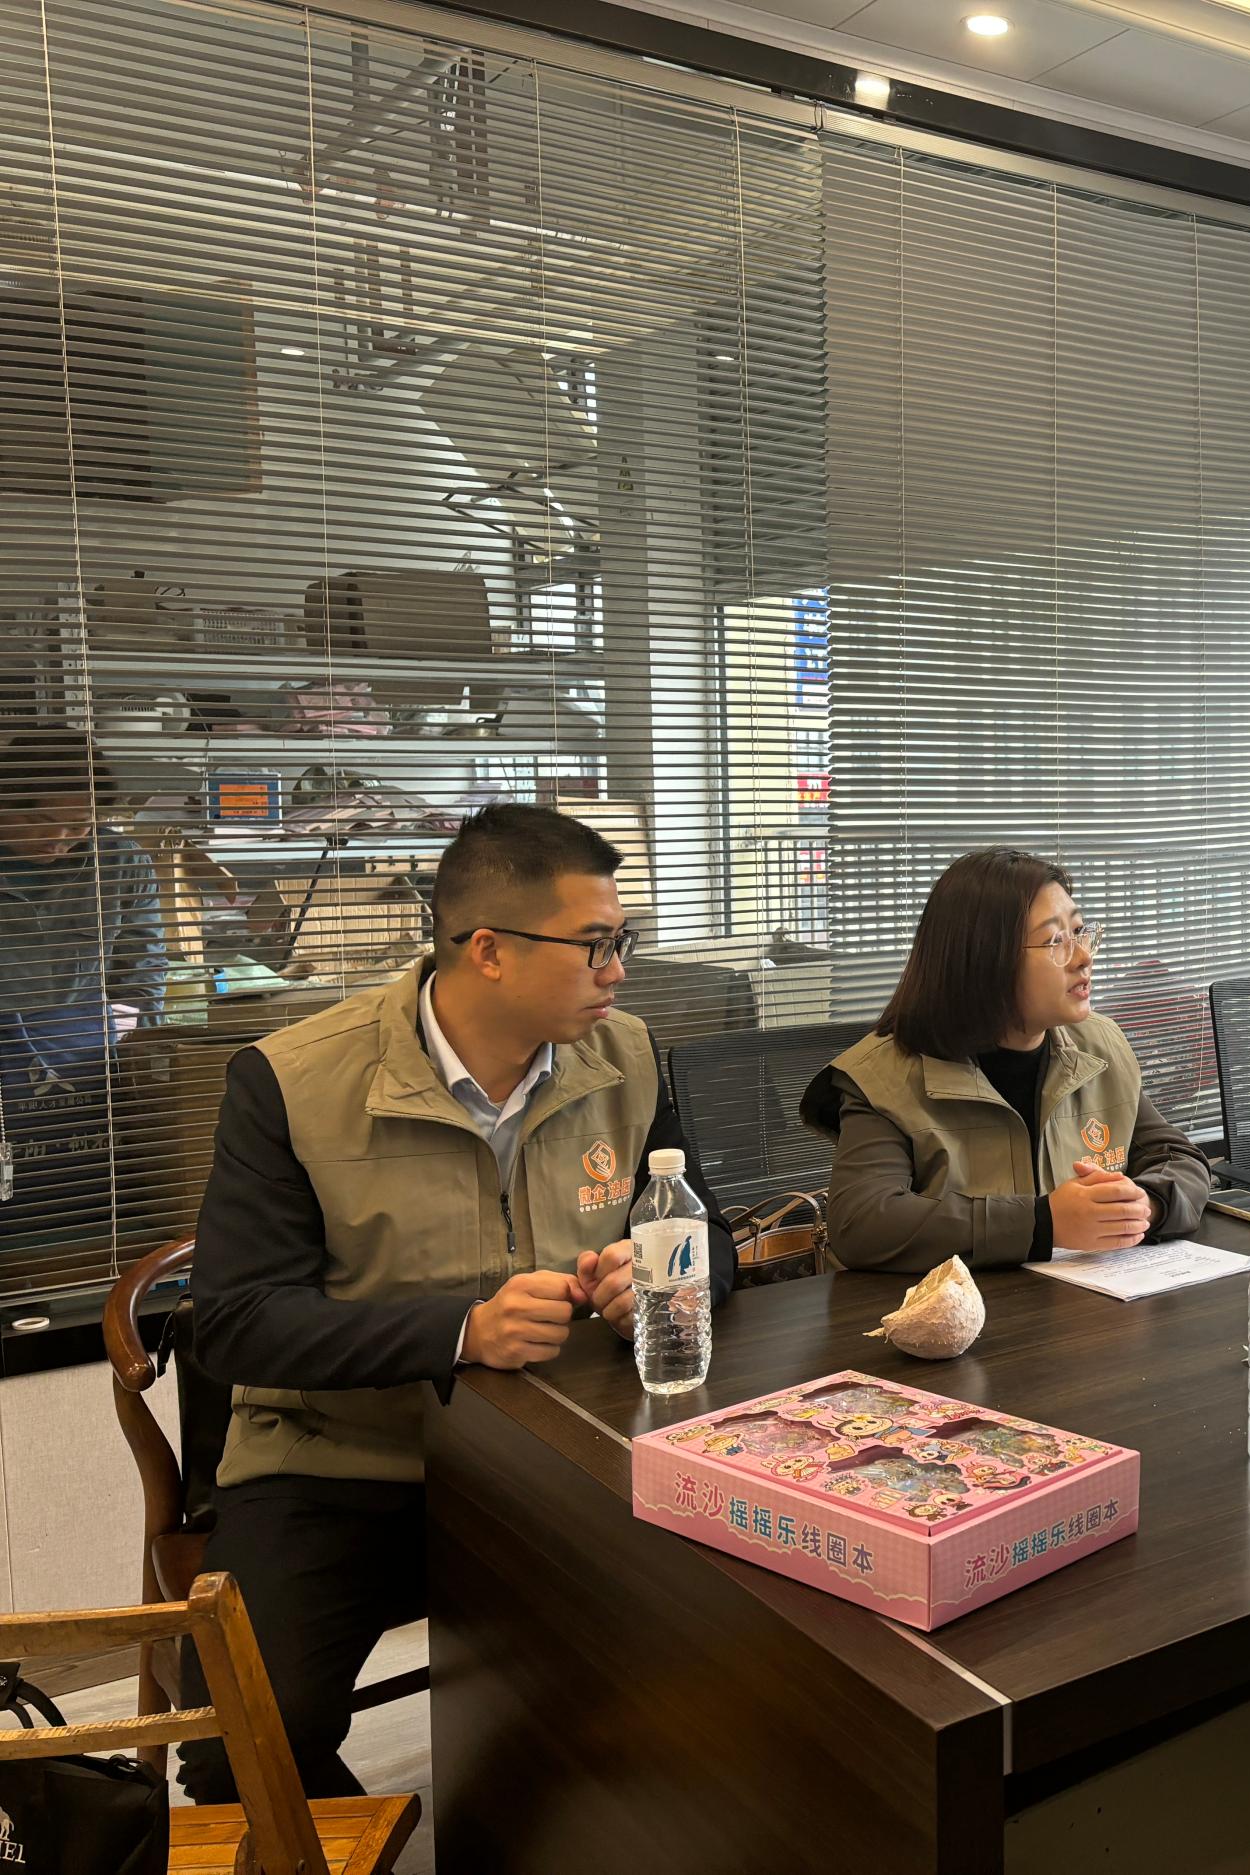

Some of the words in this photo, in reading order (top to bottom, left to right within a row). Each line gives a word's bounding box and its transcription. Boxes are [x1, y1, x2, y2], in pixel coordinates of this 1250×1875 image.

[674, 1472, 874, 1574] 流沙摇摇乐线圈本
[965, 1499, 1119, 1588] 流沙摇摇乐线圈本
[0, 1841, 26, 1864] EL
